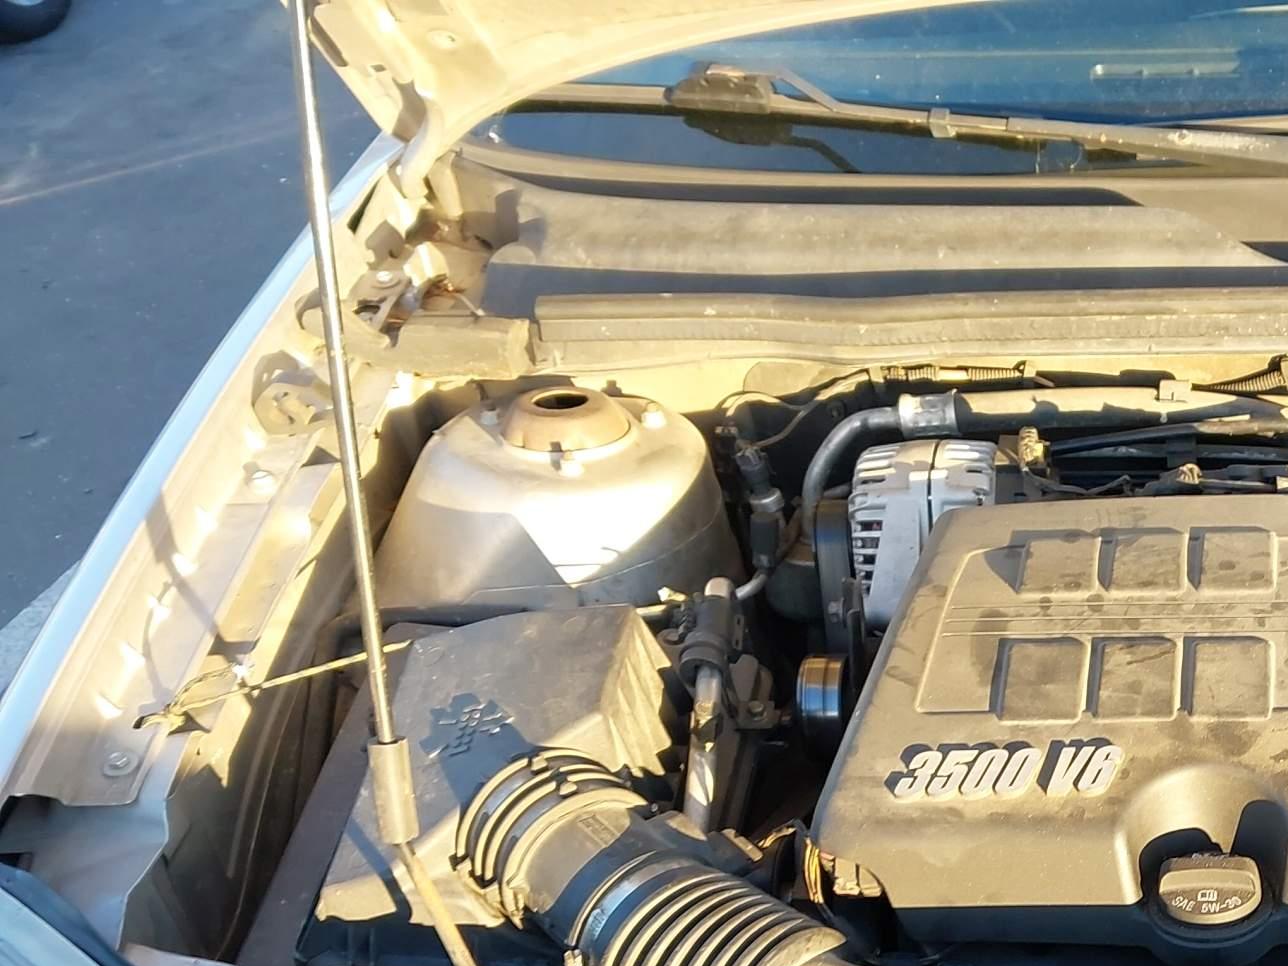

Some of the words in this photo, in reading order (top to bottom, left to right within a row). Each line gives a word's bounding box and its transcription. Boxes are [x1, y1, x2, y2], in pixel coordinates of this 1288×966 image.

[891, 747, 1043, 800] 3500
[1046, 744, 1124, 798] V6
[1172, 896, 1196, 911] SAE
